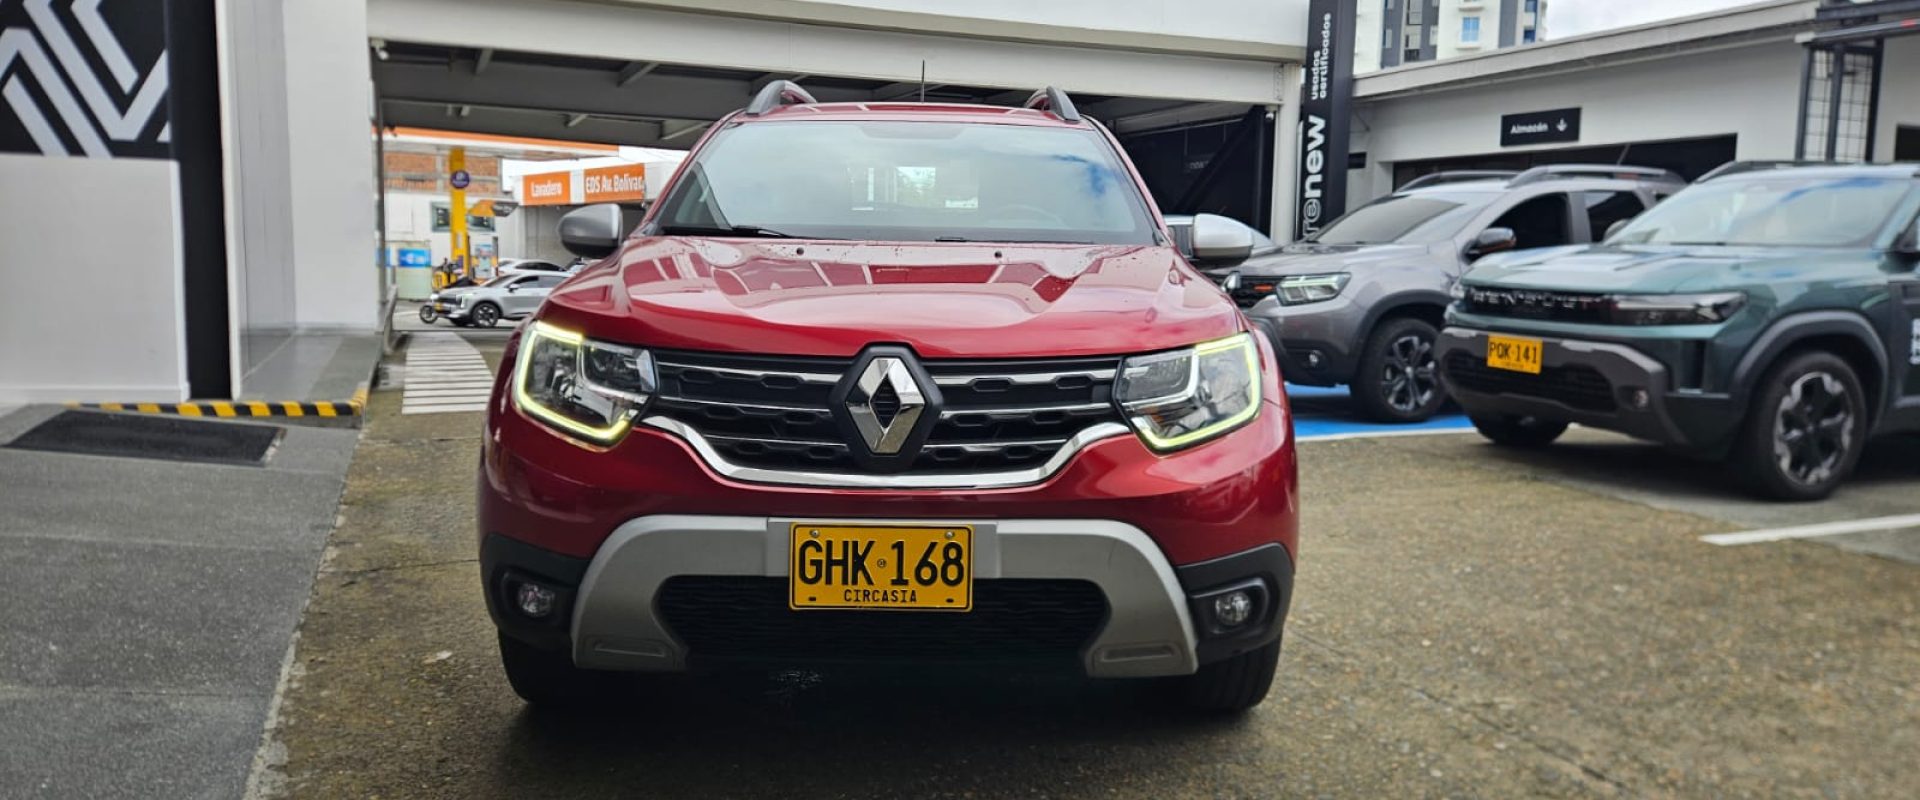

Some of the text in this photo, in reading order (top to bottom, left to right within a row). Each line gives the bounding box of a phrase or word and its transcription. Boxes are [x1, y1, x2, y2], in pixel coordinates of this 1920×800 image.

[1319, 12, 1331, 98] certificados
[1311, 50, 1320, 100] usados
[1510, 122, 1548, 134] Almacén
[530, 180, 562, 198] Lavadero
[586, 176, 600, 193] EDS
[799, 540, 964, 587] GHK 168
[844, 589, 917, 603] CIRCASIA
